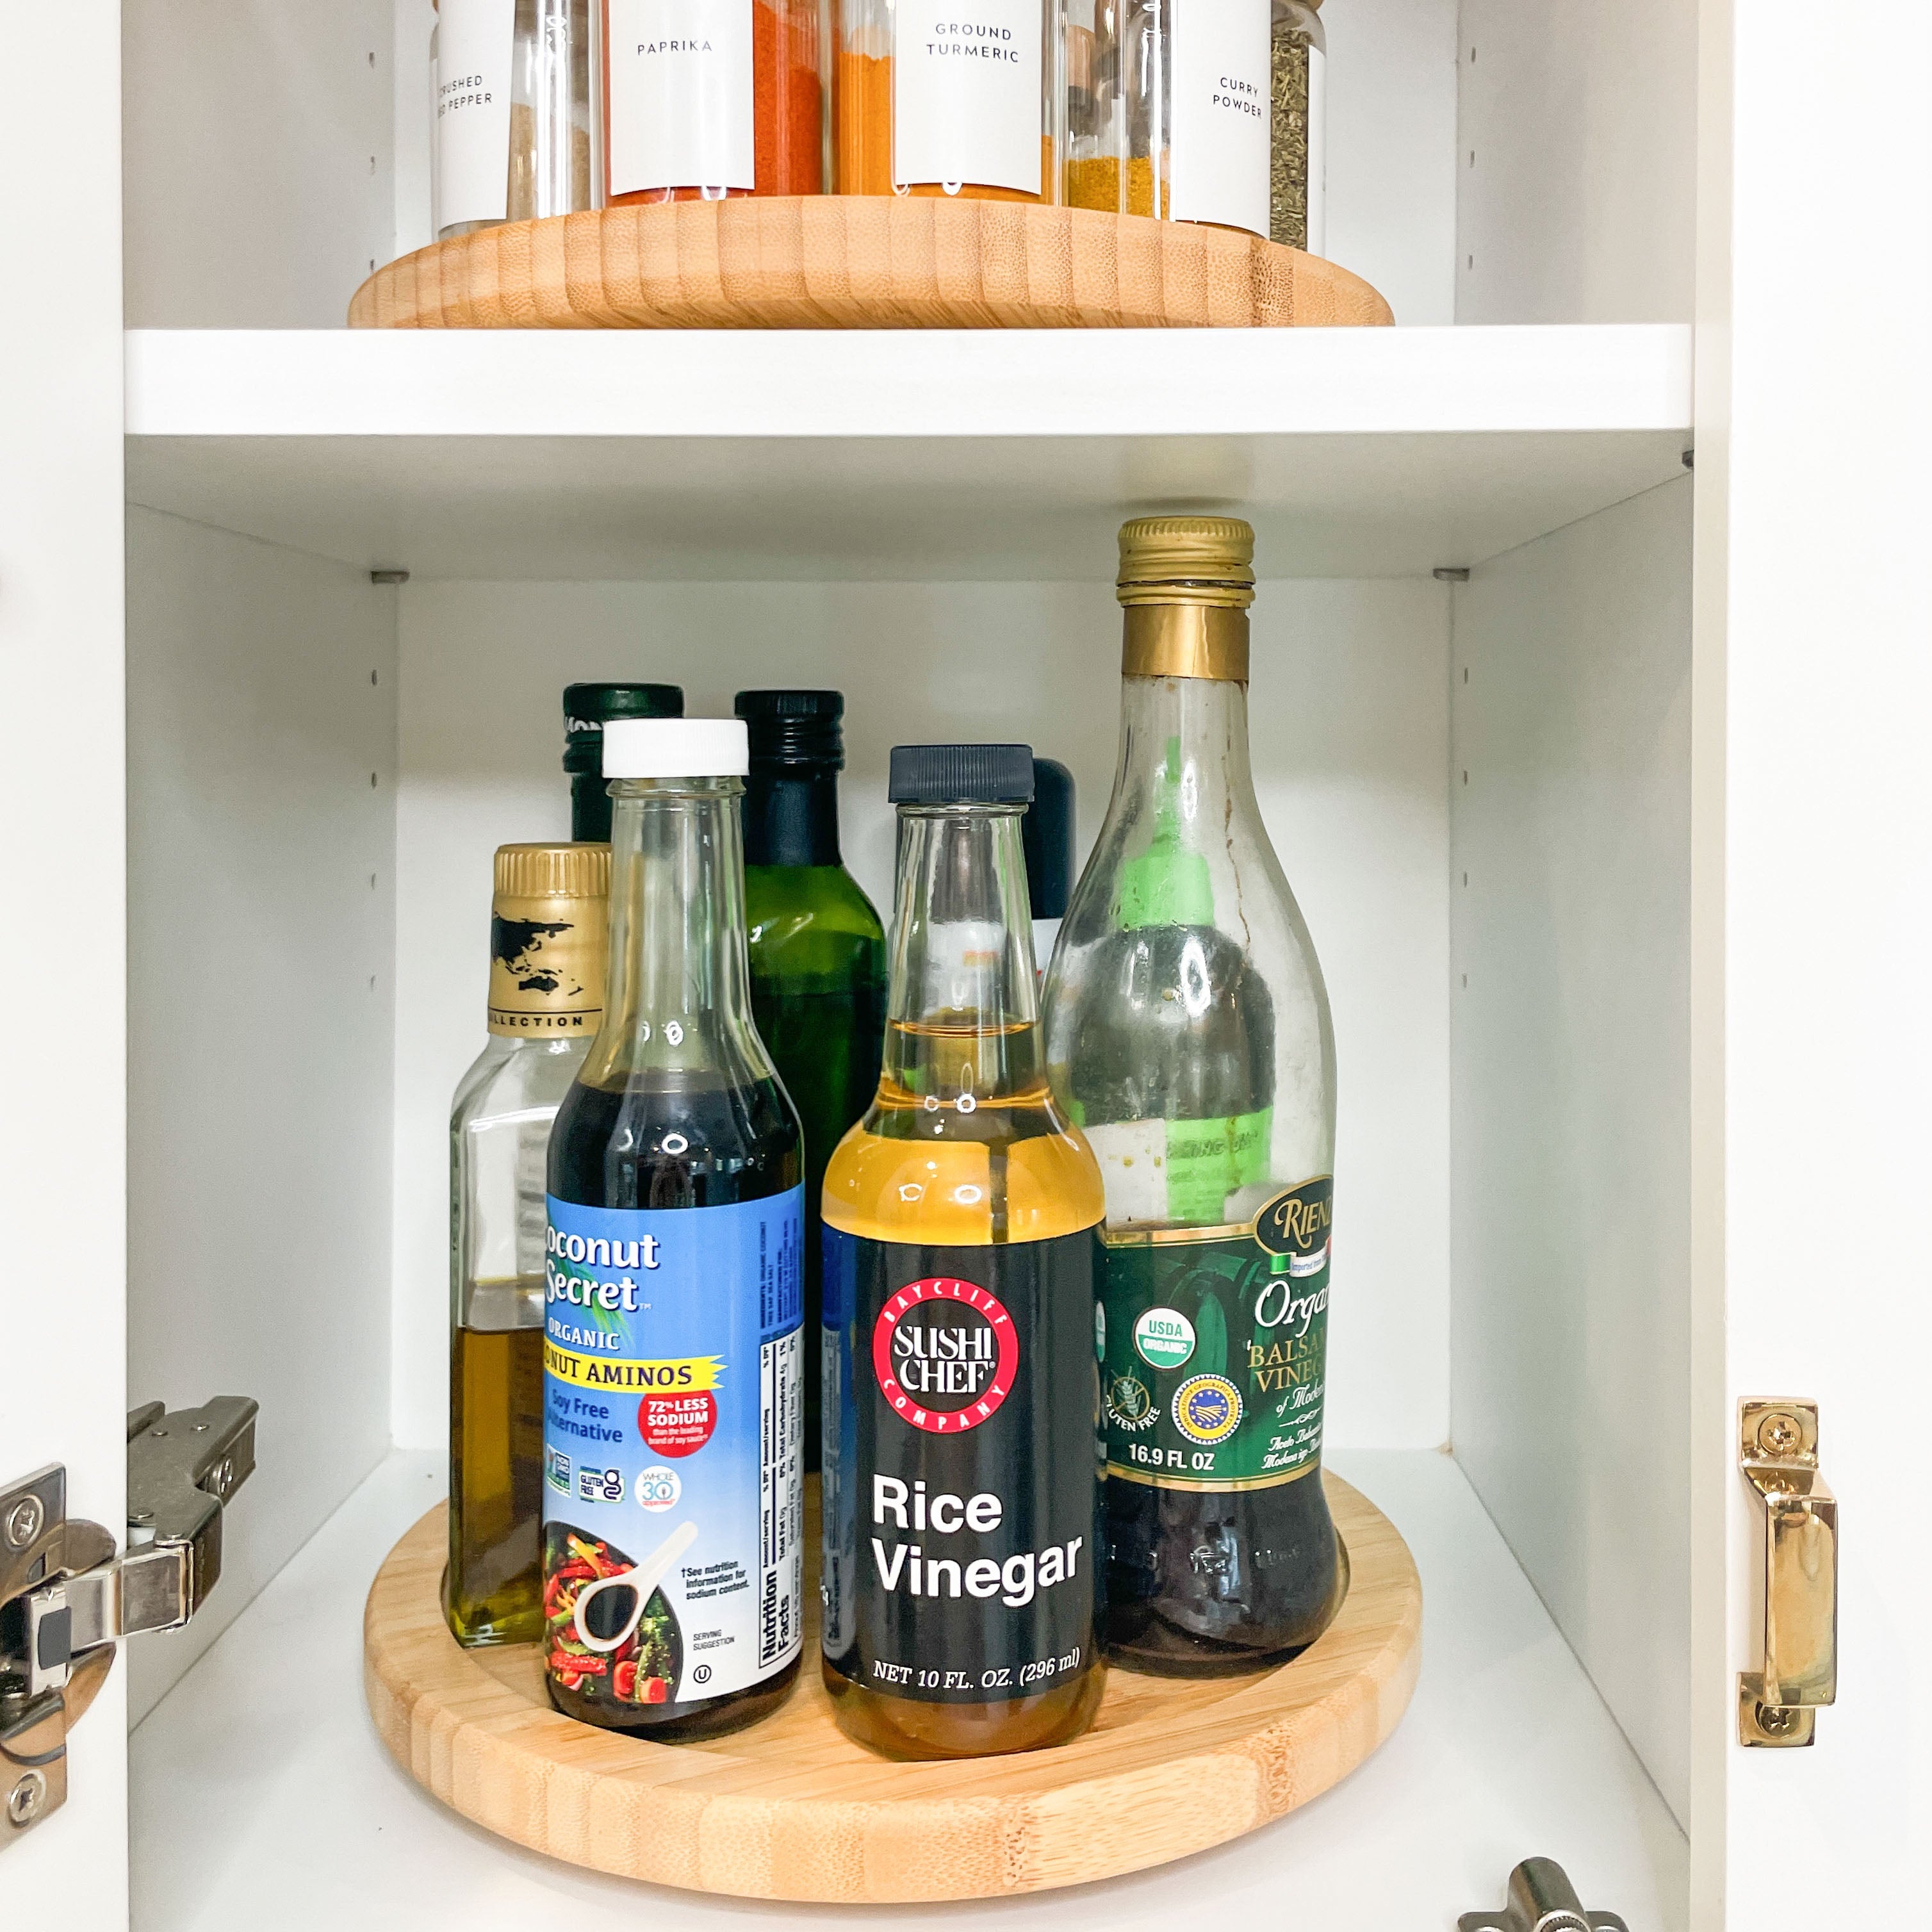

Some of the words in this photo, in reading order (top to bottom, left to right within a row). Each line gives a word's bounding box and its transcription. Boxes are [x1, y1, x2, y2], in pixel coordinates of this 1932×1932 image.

[935, 23, 1011, 40] GROUND
[637, 40, 712, 56] PAPRIKA
[926, 44, 1019, 63] TURMERIC
[1220, 77, 1258, 97] CURRY
[448, 93, 492, 111] PEPPER
[1213, 94, 1262, 119] POWDER
[489, 1015, 582, 1027] LLECTION
[1274, 1195, 1332, 1248] RIEN
[546, 1225, 659, 1269] oconut
[546, 1259, 638, 1312] Secret
[883, 1281, 1008, 1325] BAYCLIFF
[549, 1317, 620, 1351] ORGANIC
[1149, 1320, 1183, 1337] USDA
[894, 1325, 992, 1361] SUSHI
[1143, 1338, 1188, 1355] ORGANIC
[585, 1363, 692, 1386] AMINOS
[553, 1388, 571, 1414] Soy
[574, 1398, 609, 1419] Free
[675, 1397, 708, 1412] LESS
[883, 1379, 1006, 1430] COMPANY
[1276, 1396, 1289, 1418] of
[648, 1411, 708, 1427] SODIUM
[1138, 1406, 1161, 1430] FREE
[1129, 1443, 1163, 1466] 16.9
[1167, 1450, 1188, 1469] FL
[1191, 1452, 1215, 1470] OZ
[580, 1475, 604, 1487] GLUTEN
[643, 1472, 674, 1480] WHOLE
[642, 1481, 673, 1500] 30
[873, 1473, 1003, 1534] Rice
[705, 1561, 738, 1575] nutrition
[871, 1536, 1083, 1607] Vinegar
[686, 1573, 733, 1589] information
[735, 1569, 746, 1579] for
[686, 1589, 717, 1600] sodium
[762, 1570, 776, 1660] Nutrition
[778, 1594, 789, 1652] Facts
[693, 1629, 722, 1641] SERVING
[693, 1636, 735, 1651] SUGGESTION
[872, 1660, 913, 1684] NET
[918, 1670, 939, 1688] 10
[943, 1671, 974, 1689] FL.
[981, 1668, 1013, 1688] OZ.
[1019, 1658, 1055, 1687] (296
[1058, 1646, 1080, 1671] ml)
